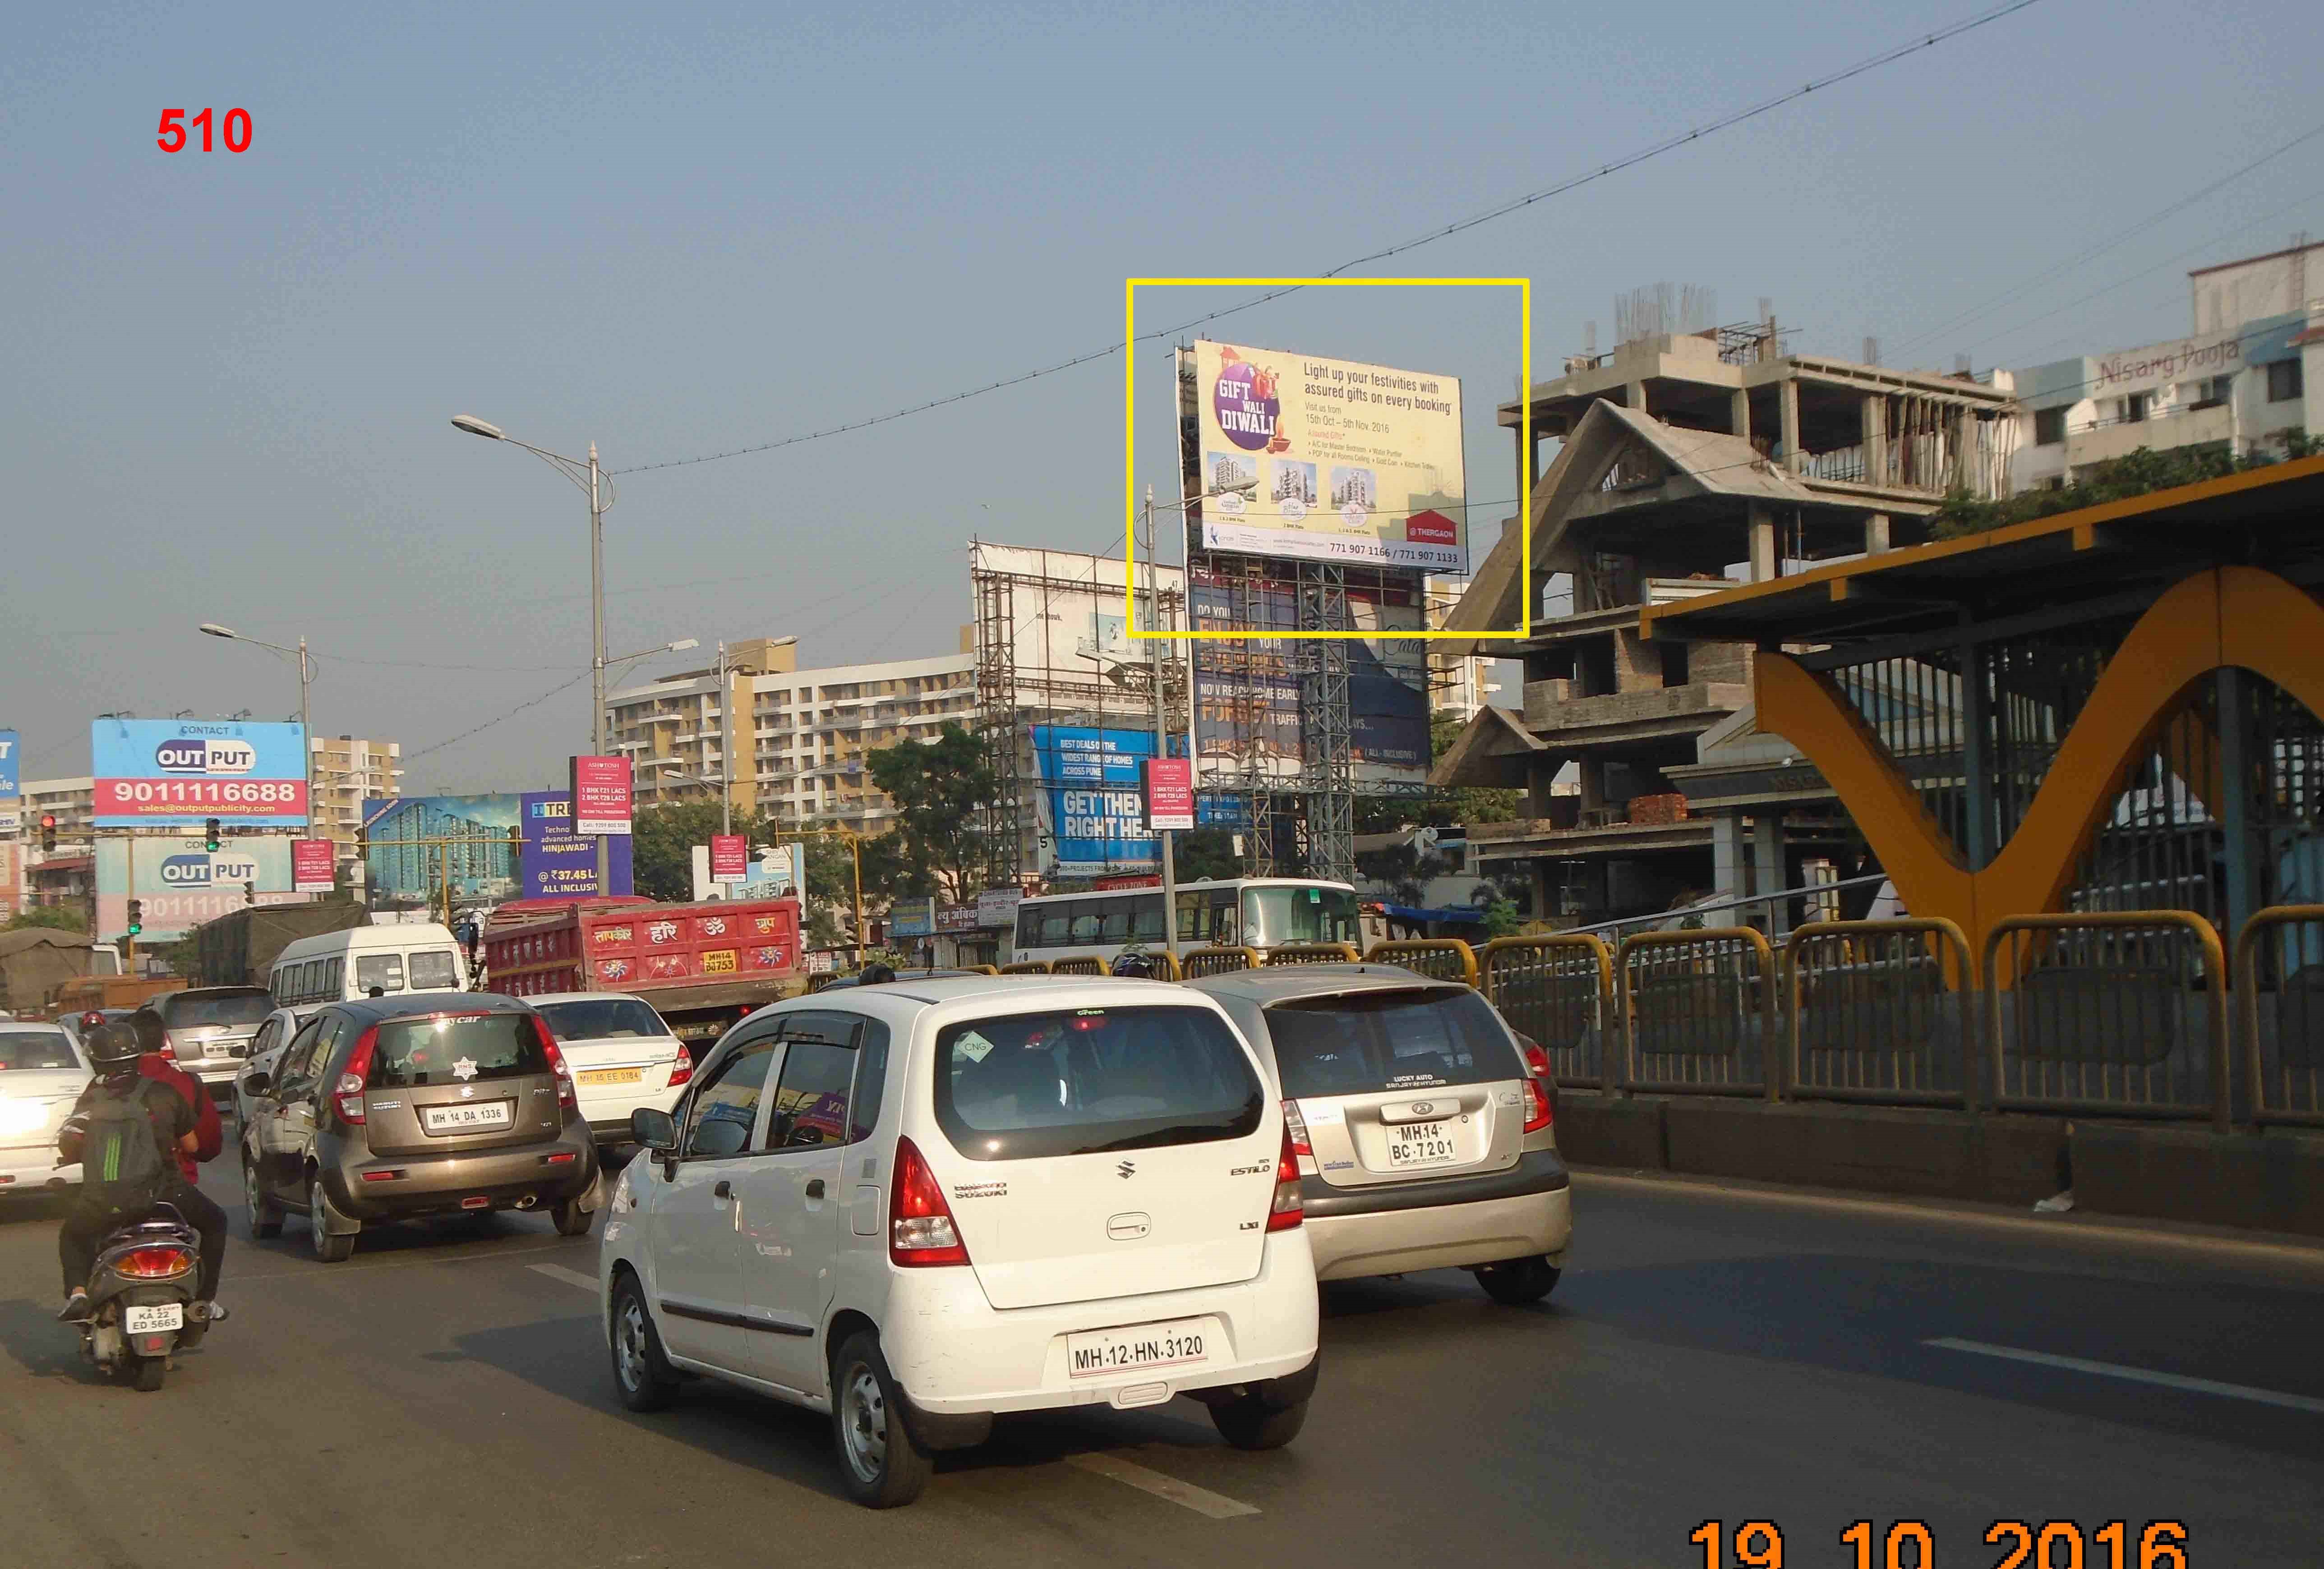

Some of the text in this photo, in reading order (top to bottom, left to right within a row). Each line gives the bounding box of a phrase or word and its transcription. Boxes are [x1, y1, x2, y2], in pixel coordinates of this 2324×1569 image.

[2095, 341, 2239, 391] Nisarg Pooja
[1304, 362, 1439, 394] Light up your festivities with
[1219, 379, 1251, 400] GIFT
[1305, 383, 1344, 399] assured
[1347, 387, 1368, 402] gifts
[1371, 393, 1383, 404] on
[1386, 394, 1412, 411] every
[1242, 400, 1265, 414] WALI
[1305, 401, 1318, 411] Visit
[1328, 405, 1342, 414] from
[1221, 409, 1274, 435] DIWALI
[1306, 414, 1321, 424] 15th
[1323, 416, 1335, 426] Oct
[1343, 418, 1354, 429] 5th
[1372, 421, 1389, 433] 2016
[1409, 527, 1454, 538] @ THERGAON
[1330, 543, 1346, 553] 771
[1349, 544, 1365, 554] 907
[1369, 546, 1391, 557] 1166
[1393, 549, 1397, 559] /
[1399, 550, 1416, 560] 771
[1418, 551, 1434, 561] 907
[1436, 552, 1458, 563] 1133
[1198, 604, 1231, 617] DO YOU
[1259, 637, 1282, 649] YOUR
[1200, 683, 1220, 696] NOW
[1277, 688, 1301, 700] EARLY
[181, 726, 229, 736] CONTACT
[1061, 739, 1075, 749] BEST
[1076, 740, 1095, 750] DEALS
[1104, 742, 1116, 751] THE
[1061, 753, 1084, 762] WIDEST
[1105, 755, 1113, 764] OF
[1113, 756, 1133, 765] HOMES
[1062, 766, 1102, 776] ACROSS PUNE
[115, 782, 295, 802] 9011116688
[138, 804, 275, 814] sales@outputpublicity.com
[1064, 791, 1098, 815] GET
[1065, 817, 1117, 841] RIGHT
[185, 840, 233, 849] CONCT
[542, 843, 588, 853] HINJAWADI
[538, 870, 586, 882] @ ₹37.45
[543, 883, 559, 893] ALL
[1129, 881, 1148, 891] ZONE
[140, 895, 283, 917] 9011116
[650, 920, 678, 944] हरि
[708, 952, 732, 962] MH14
[964, 1043, 987, 1051] CNG
[607, 1073, 618, 1081] EE
[621, 1072, 639, 1080] 0184
[1393, 1075, 1415, 1083] LUCKY
[432, 1108, 502, 1125] MH 14 DA 1336
[1231, 1165, 1270, 1176] ESTILO
[954, 1190, 1007, 1199] SUZUKI
[133, 1321, 148, 1330] ED
